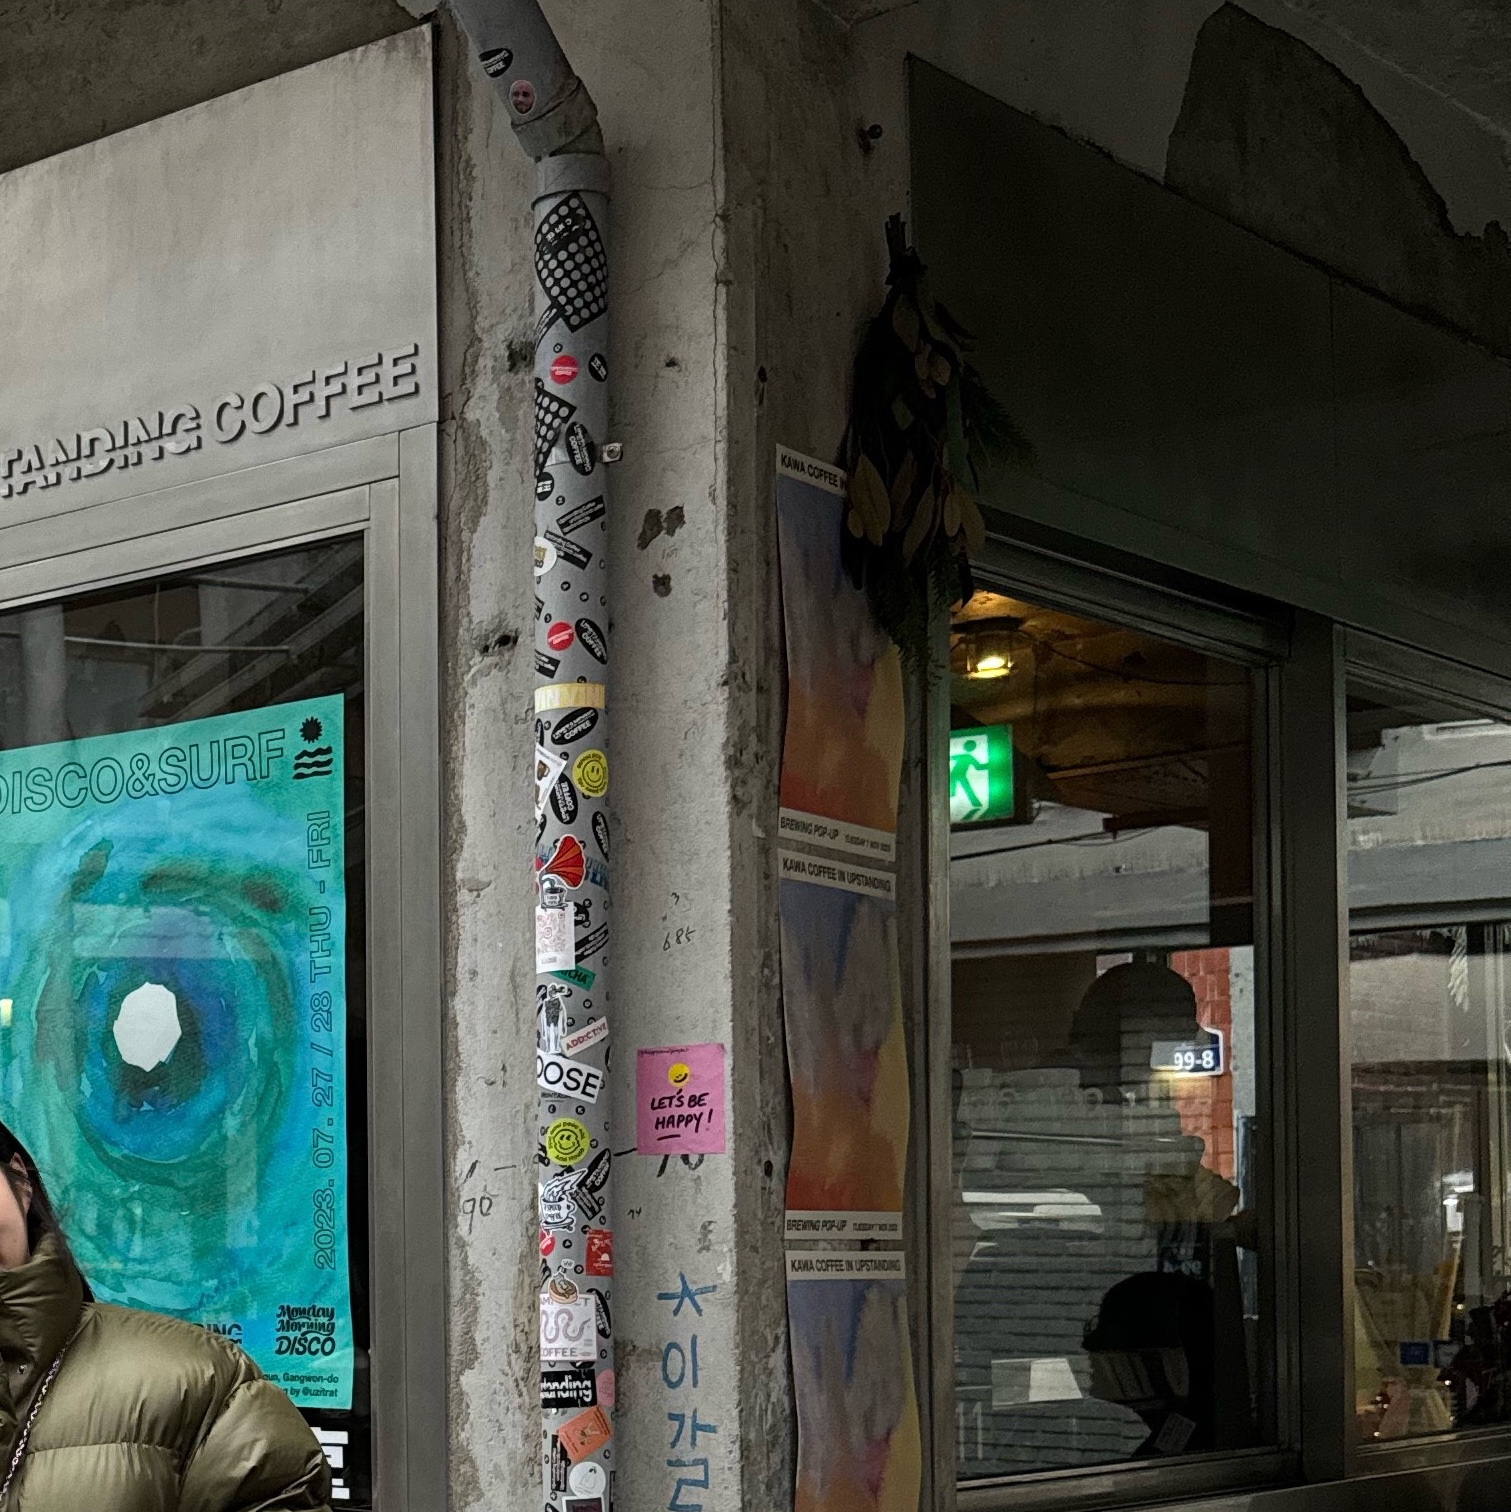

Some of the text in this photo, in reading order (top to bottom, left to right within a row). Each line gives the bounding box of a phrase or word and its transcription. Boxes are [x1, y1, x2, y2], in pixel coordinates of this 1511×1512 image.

[215, 342, 420, 443] COFFEE
[781, 453, 805, 473] KAWA
[807, 464, 838, 487] COFFEE
[564, 721, 592, 740] COFFEE
[307, 810, 332, 869] FRI
[780, 816, 813, 835] BREWING
[813, 824, 839, 840] POP-UP
[782, 858, 891, 893] KAWA COFFEE IN UPSTANDING
[310, 905, 332, 986] THU
[311, 990, 332, 1033] 28
[1173, 1049, 1215, 1071] 99-8
[312, 1066, 334, 1107] 27
[650, 1088, 710, 1111] LET'S BE
[312, 1115, 334, 1168] 07.
[314, 1178, 337, 1270] 2023.
[786, 1219, 820, 1232] BREWING
[821, 1219, 847, 1232] POP-UP
[791, 1259, 901, 1272] KAWA COFFEE IN UPSTANDING
[276, 1304, 335, 1321] Monday
[275, 1319, 336, 1337] Morning
[275, 1335, 336, 1357] DISCO
[282, 1372, 339, 1384] Gangwon-do
